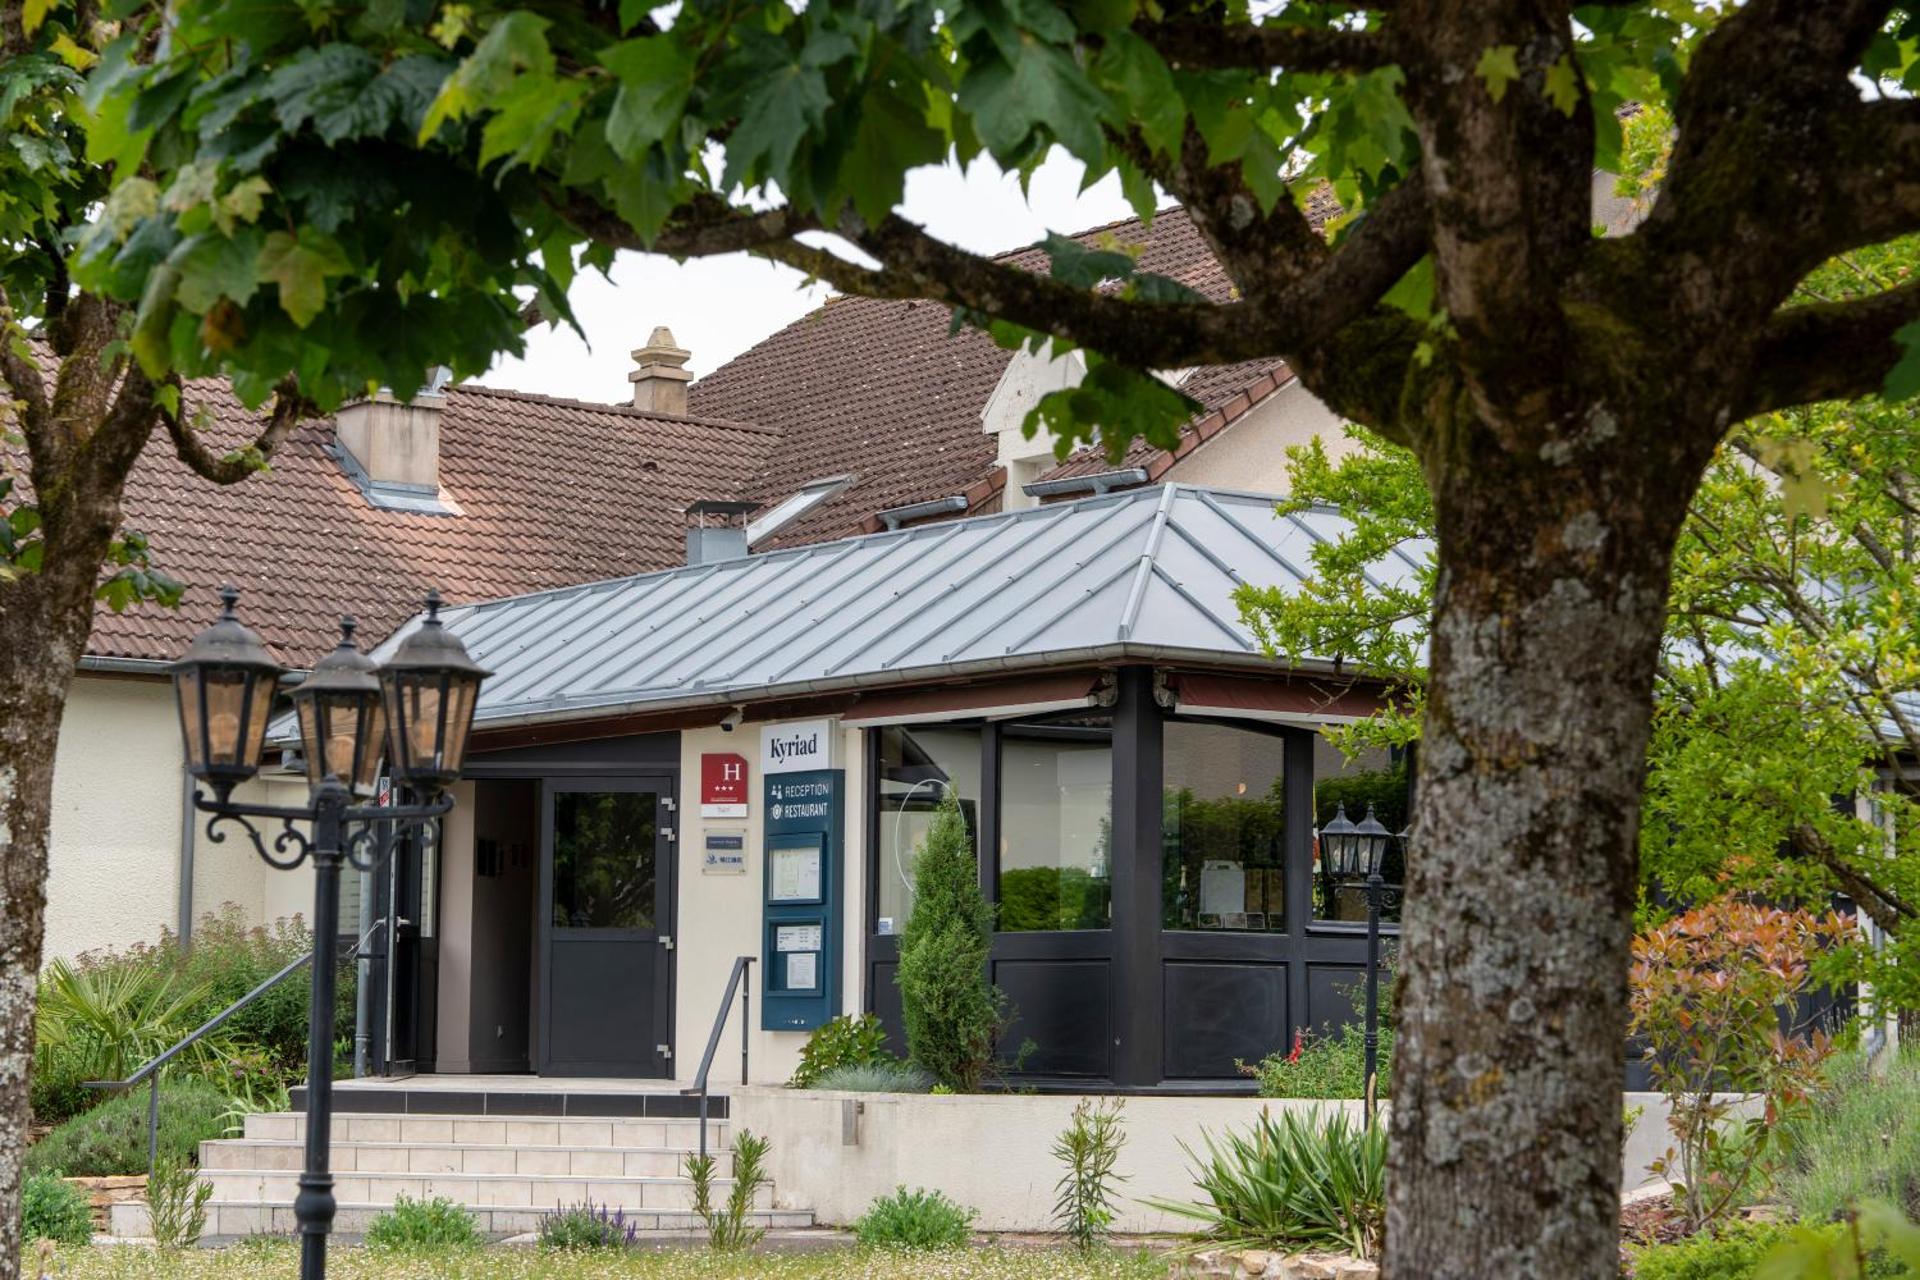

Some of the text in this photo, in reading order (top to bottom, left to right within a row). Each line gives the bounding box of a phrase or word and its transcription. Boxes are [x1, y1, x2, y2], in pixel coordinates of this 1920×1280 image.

[770, 733, 817, 764] Kyriad
[723, 763, 741, 781] H
[785, 783, 829, 797] RECEPTION
[785, 803, 828, 818] RESTAURANT
